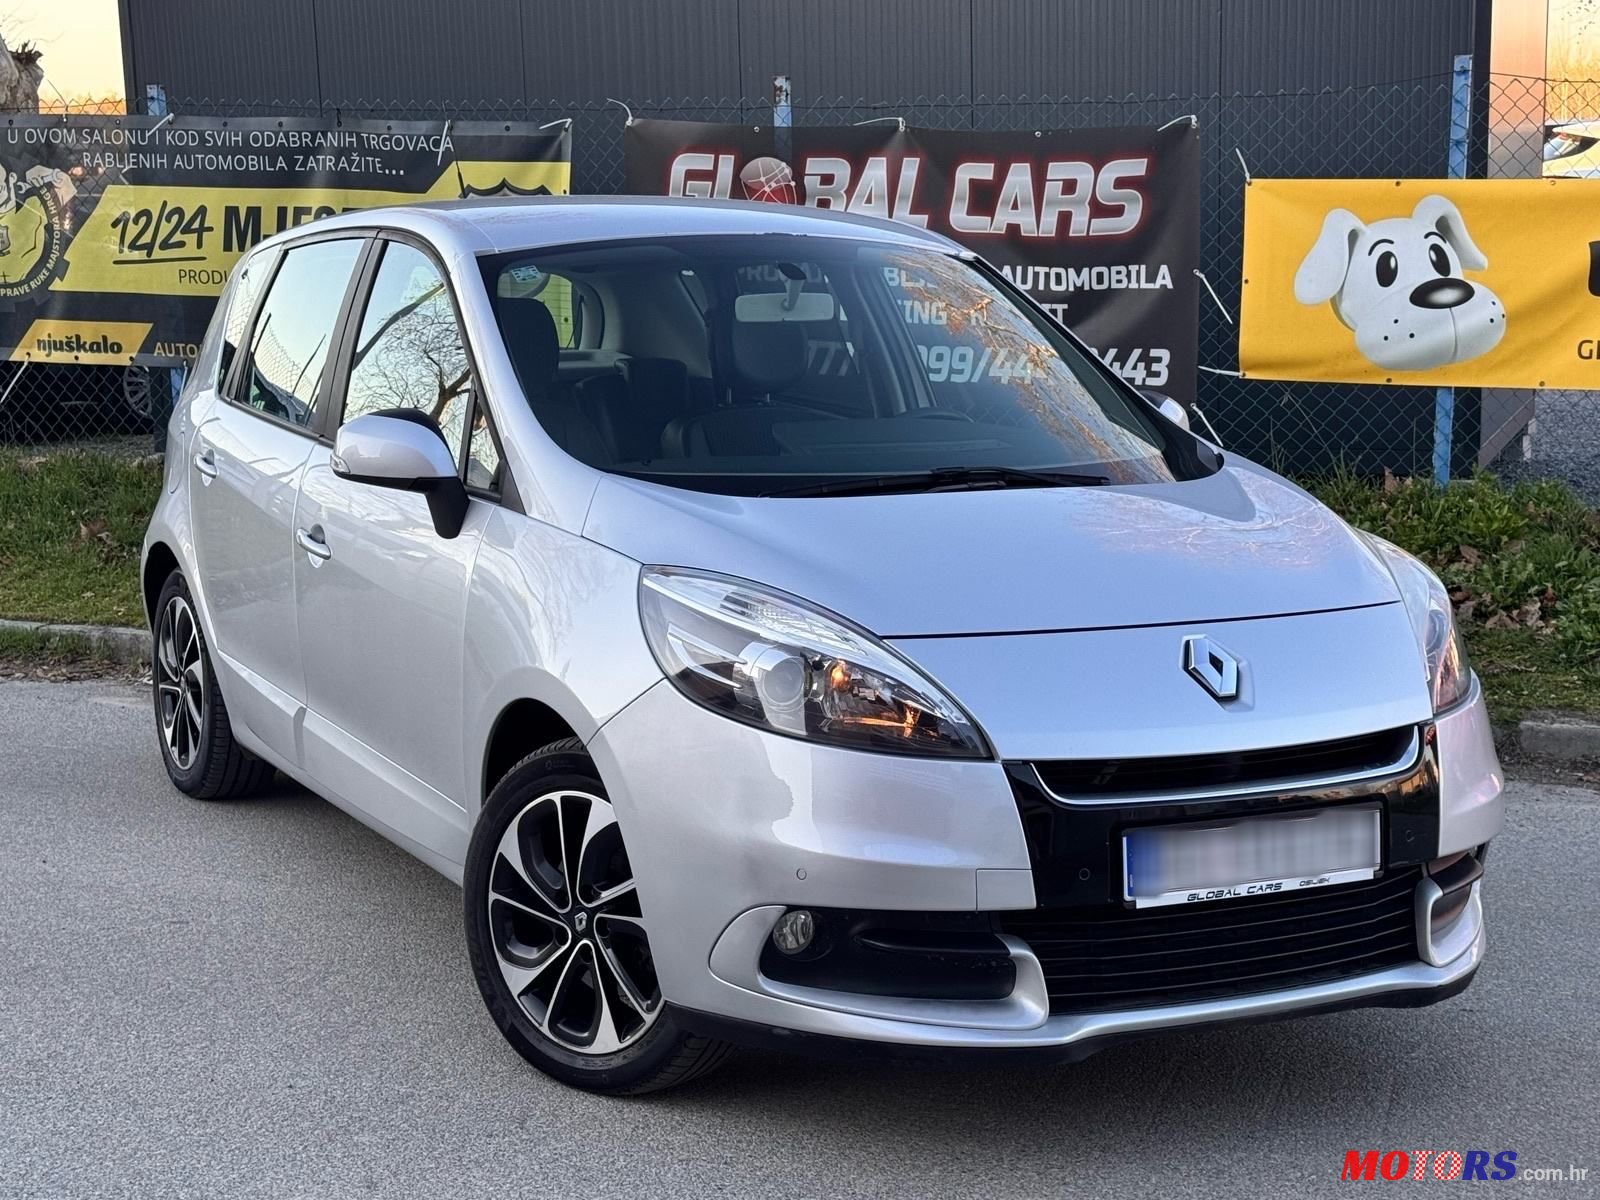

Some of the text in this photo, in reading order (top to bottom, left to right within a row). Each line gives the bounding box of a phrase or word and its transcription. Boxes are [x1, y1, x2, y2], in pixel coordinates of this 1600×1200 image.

[7, 129, 454, 152] U OVOM SALONU I KOD SVIH ODABRANIH TRGOVACA
[83, 152, 168, 169] RABLJENIH
[174, 154, 288, 171] AUTOMOBILA
[949, 158, 1148, 236] CARS
[111, 200, 214, 258] 12/24
[29, 267, 50, 289] RUKE
[47, 215, 61, 270] MAJSTORA
[36, 333, 123, 358] njuškalo
[1187, 888, 1242, 902] GLOBAL
[1246, 882, 1283, 895] CARS
